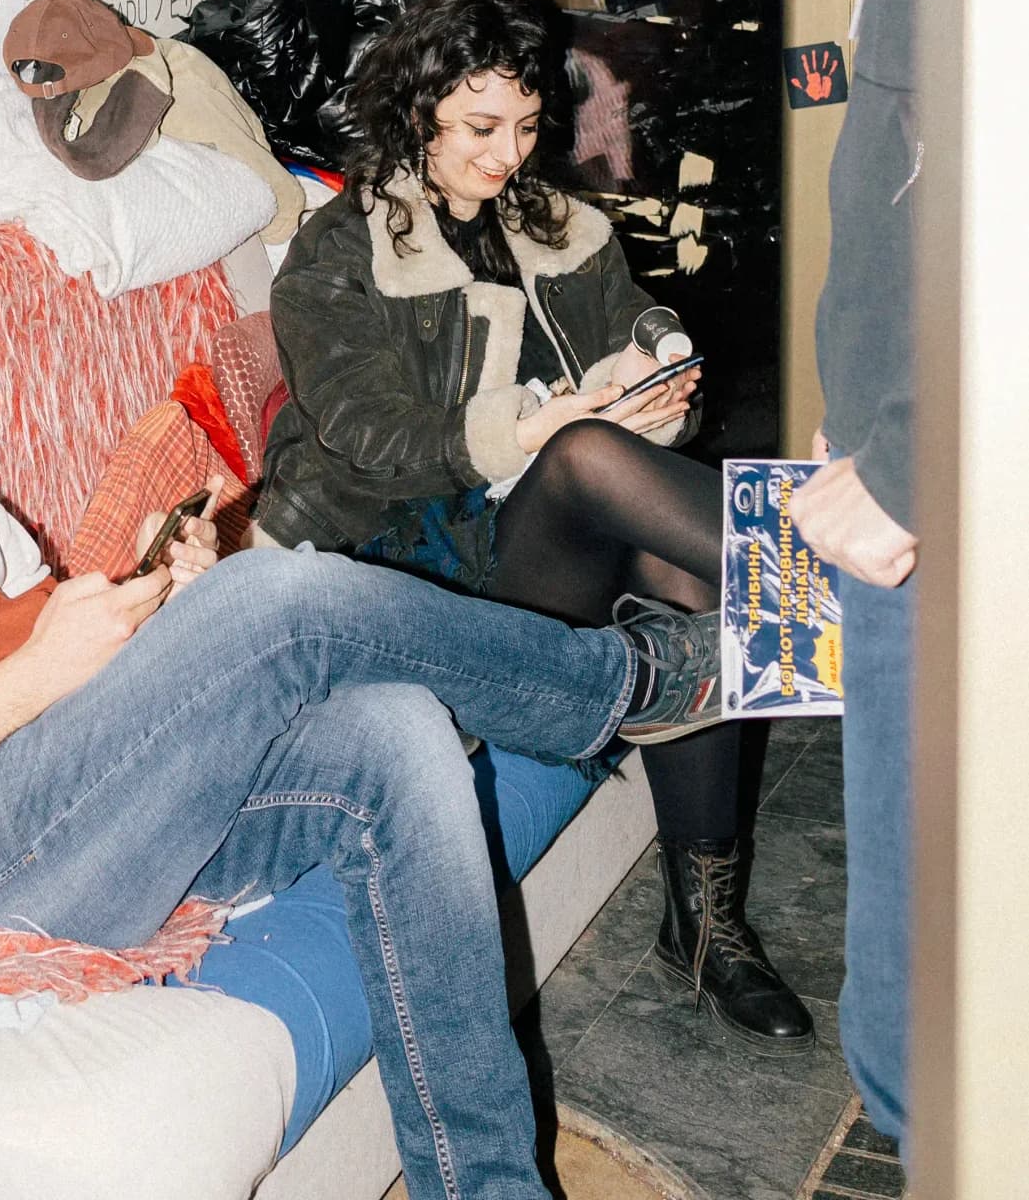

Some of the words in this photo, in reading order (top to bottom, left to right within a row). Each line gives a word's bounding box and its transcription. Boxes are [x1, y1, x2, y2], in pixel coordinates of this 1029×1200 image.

[748, 539, 762, 634] ТРИБИНА
[779, 479, 794, 619] ТРГОВИНСКИХ
[795, 548, 809, 626] ЛАНАЦА
[779, 623, 795, 698] БОЈКОТ
